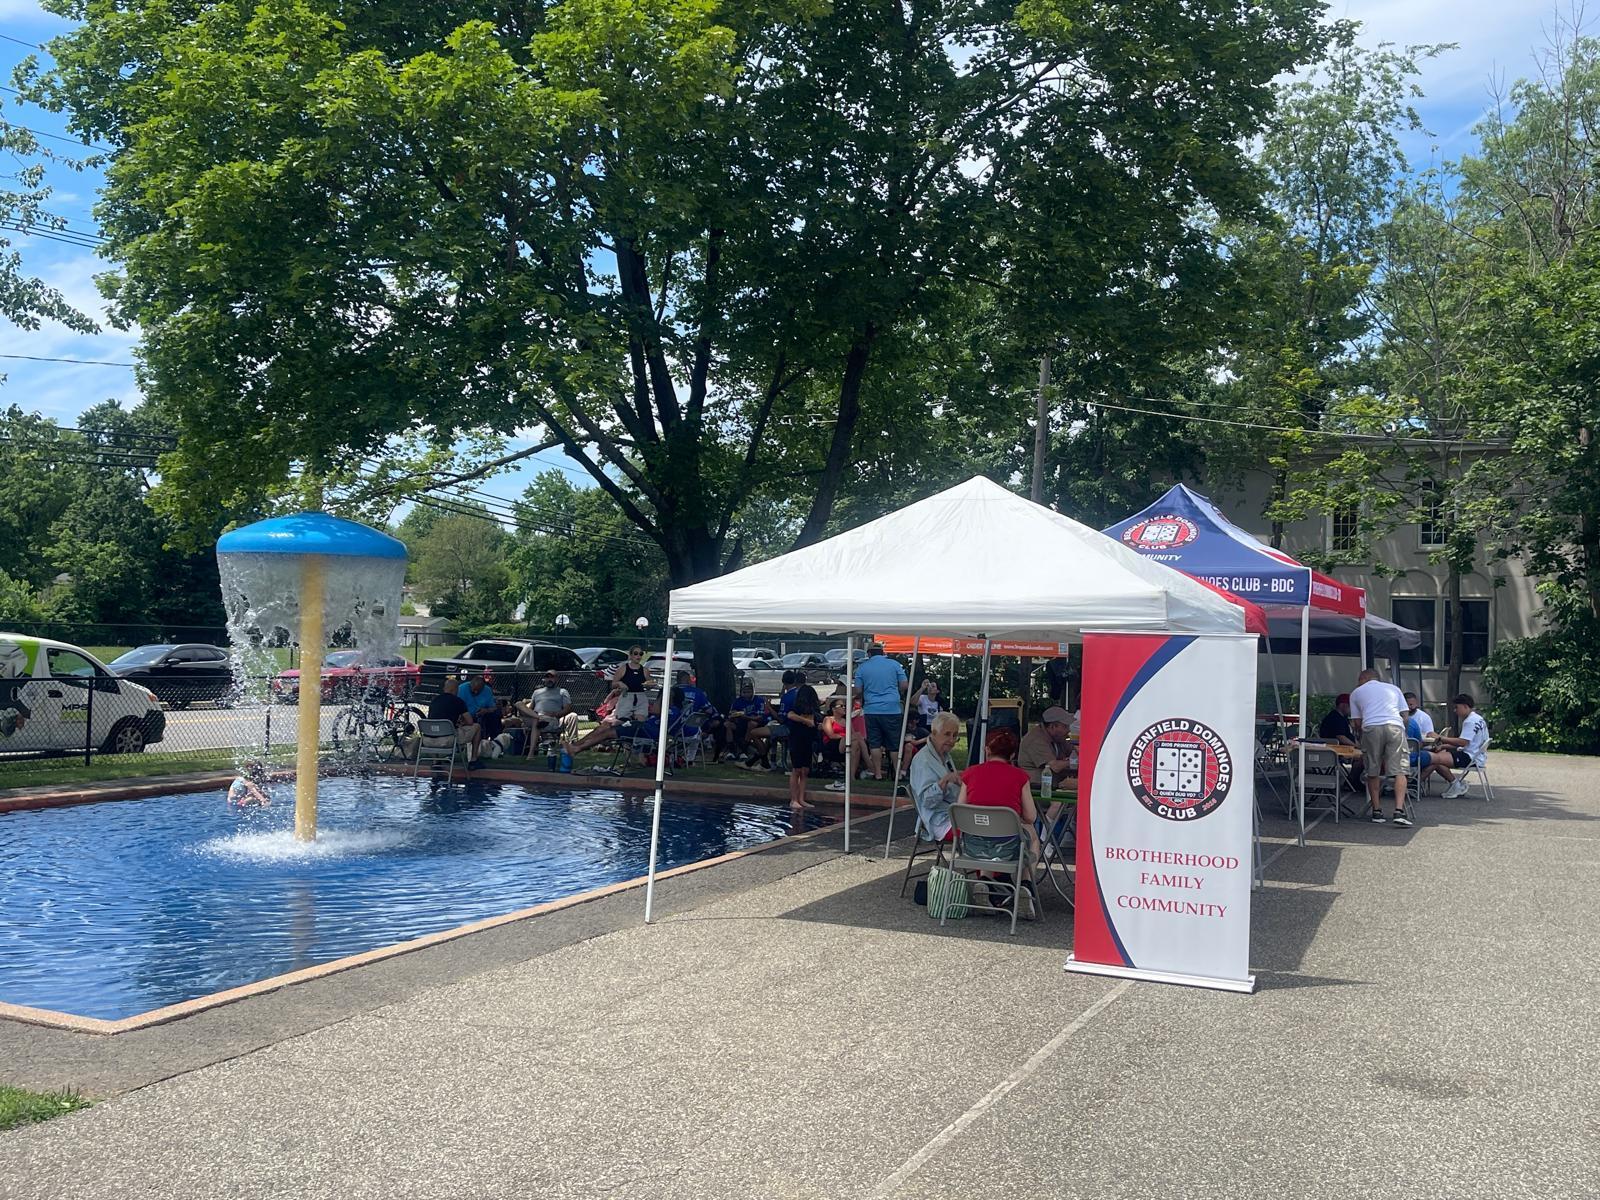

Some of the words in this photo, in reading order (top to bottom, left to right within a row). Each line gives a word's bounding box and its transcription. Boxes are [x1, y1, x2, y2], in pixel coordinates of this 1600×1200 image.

[1231, 577, 1261, 592] CLUB
[1271, 578, 1295, 593] BDC
[1129, 720, 1190, 787] BERGENFIELD
[1192, 723, 1230, 792] DOMINOES
[1157, 804, 1197, 820] CLUB
[1105, 847, 1239, 870] BROTHERHOOD
[1141, 872, 1205, 890] FAMILY
[1117, 894, 1228, 918] COMMUNITY
